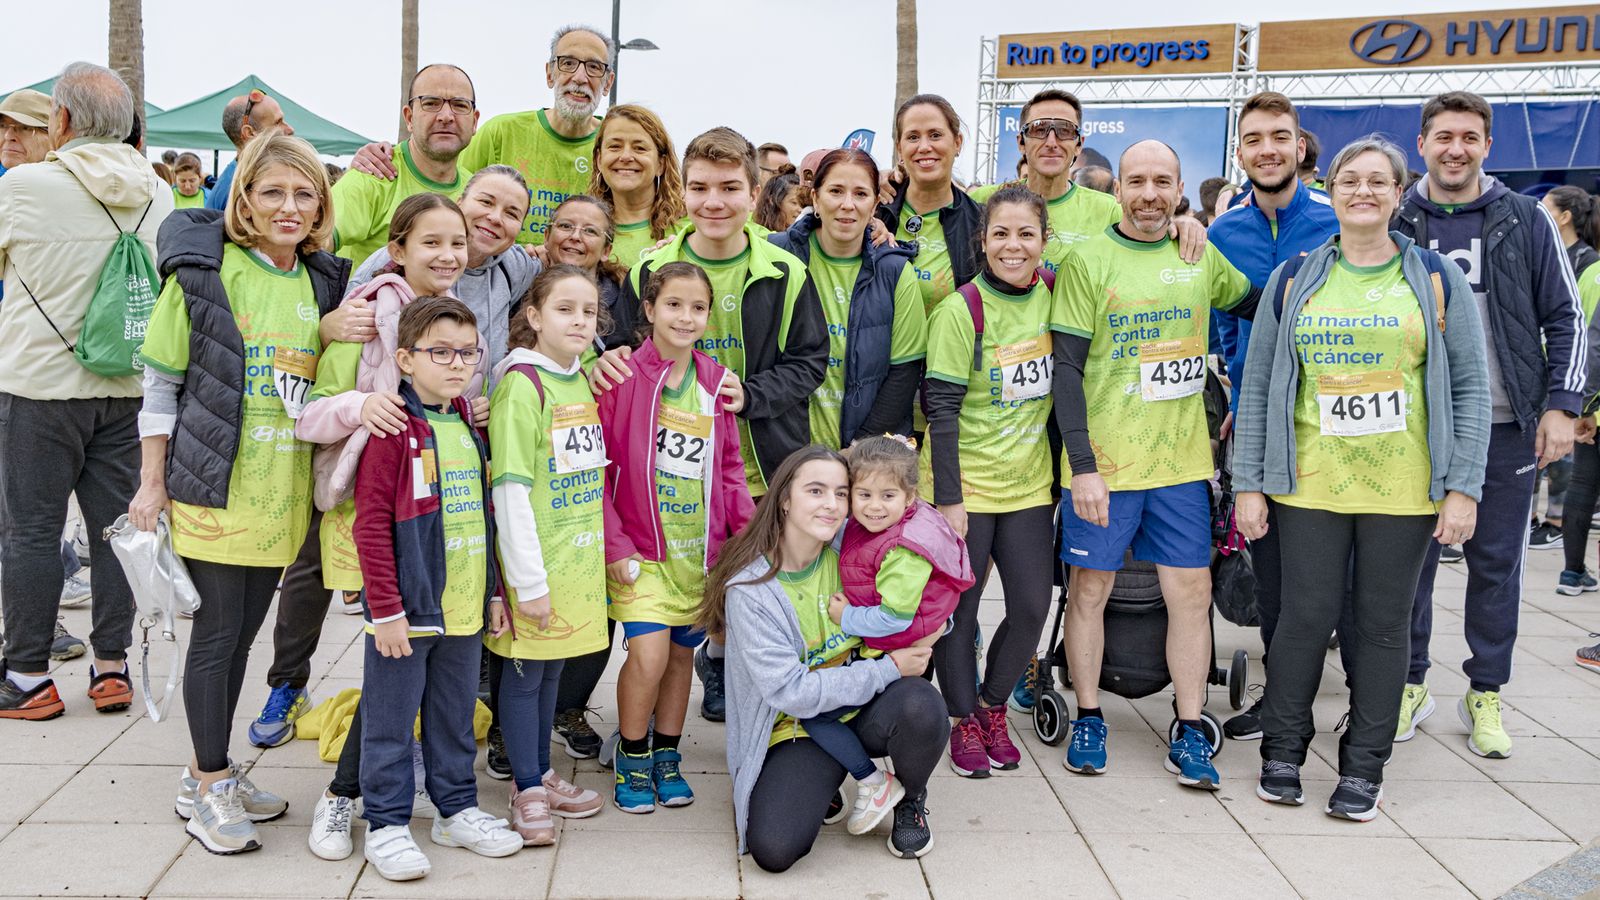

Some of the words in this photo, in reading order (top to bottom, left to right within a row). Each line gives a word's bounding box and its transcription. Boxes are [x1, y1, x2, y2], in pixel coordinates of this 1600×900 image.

[1007, 43, 1055, 66] Run
[1060, 41, 1086, 64] to
[1091, 39, 1210, 69] progress
[1083, 121, 1125, 136] gress
[1108, 313, 1129, 328] En
[1134, 305, 1191, 324] marcha
[1318, 314, 1399, 327] marcha
[1113, 327, 1160, 343] contra
[1295, 331, 1355, 345] contra
[1111, 346, 1125, 360] el
[1313, 348, 1385, 365] cáncer
[1012, 354, 1053, 386] 431
[1151, 356, 1203, 385] 4322
[1331, 391, 1400, 420] 4611
[565, 425, 603, 454] 4319
[656, 427, 705, 463] 432
[445, 467, 481, 481] march
[549, 470, 599, 491] contra
[445, 499, 481, 513] cánce
[551, 492, 568, 509] el
[660, 501, 699, 514] ncer
